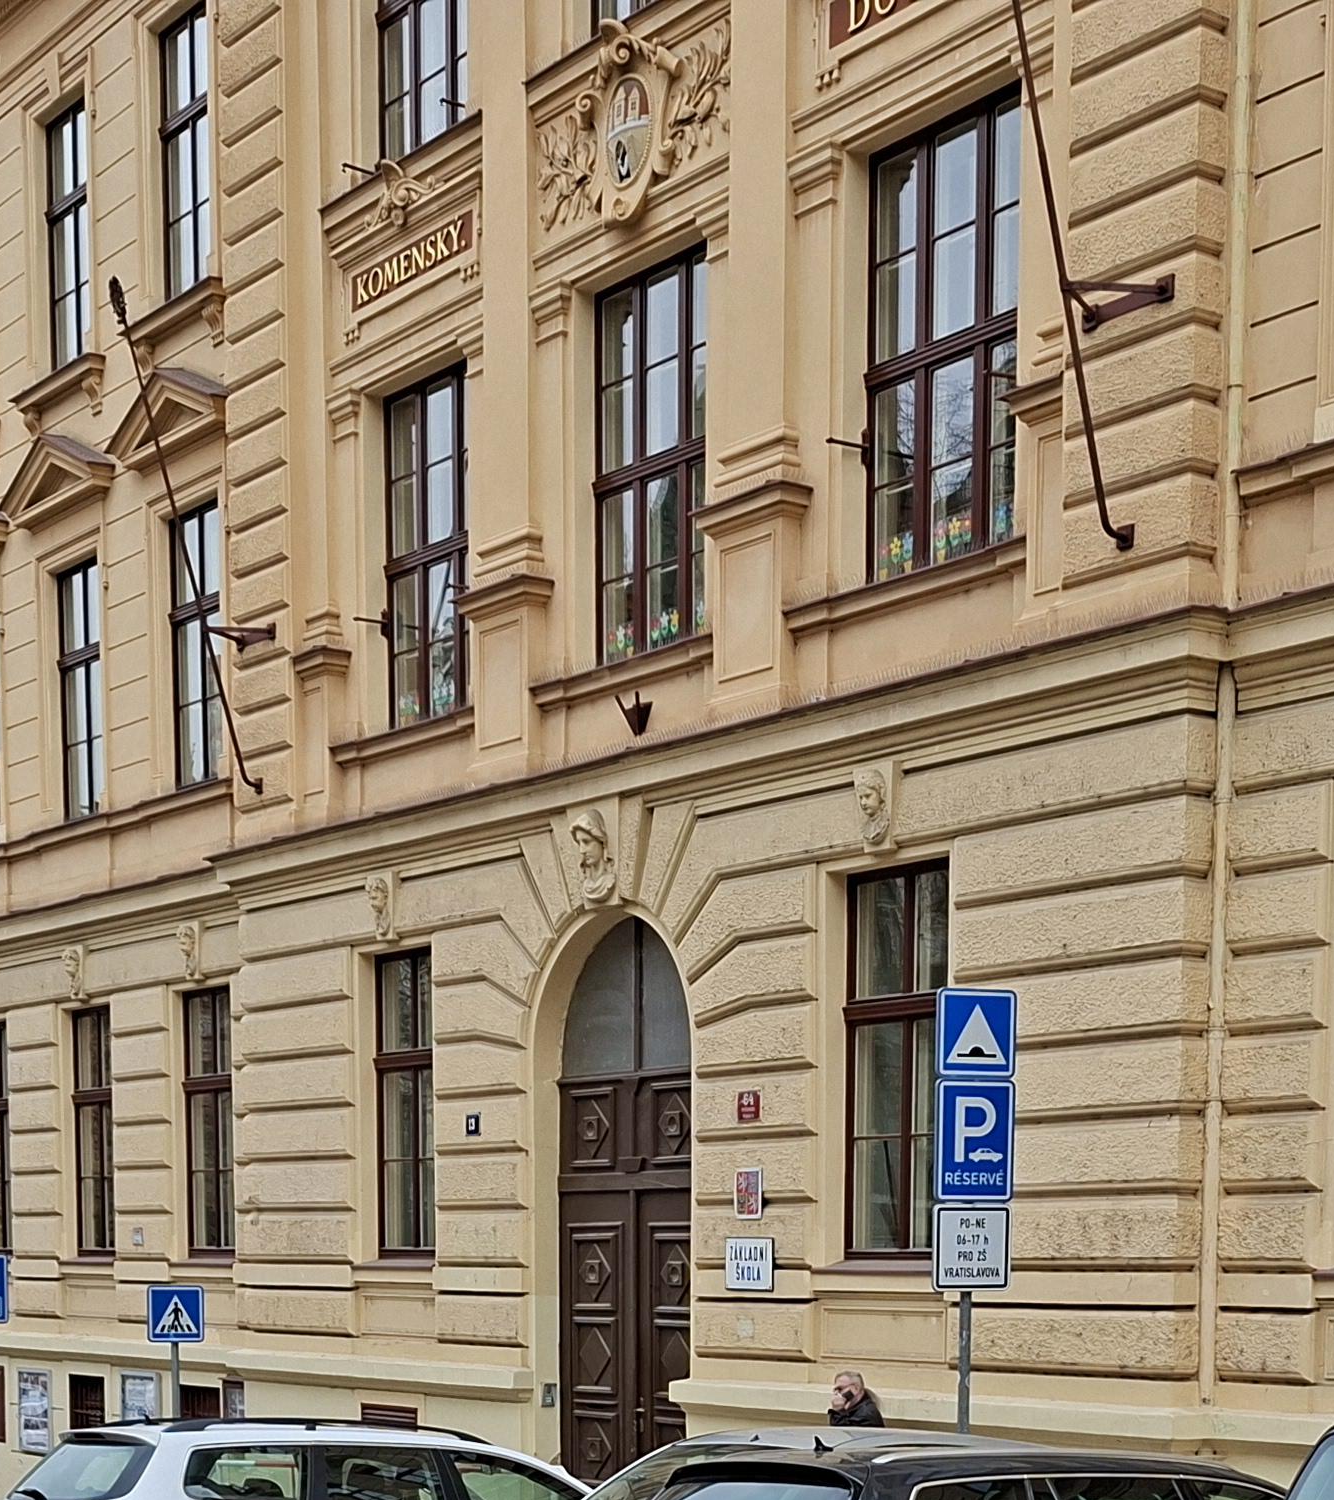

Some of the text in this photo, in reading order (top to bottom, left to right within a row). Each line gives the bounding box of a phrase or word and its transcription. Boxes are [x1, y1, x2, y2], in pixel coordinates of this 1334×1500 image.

[357, 215, 466, 305] KOMENSKÝ.
[954, 1096, 997, 1162] P
[944, 1168, 1004, 1186] RÉSERVÉ
[960, 1218, 986, 1229] PO-NE
[956, 1234, 989, 1246] 06-17 h
[730, 1241, 768, 1262] ZÁKLADNÍ
[958, 1248, 987, 1262] PRO ZŠ
[736, 1262, 762, 1281] ŠKOLA
[944, 1267, 1000, 1278] VRATISLAVOVA
